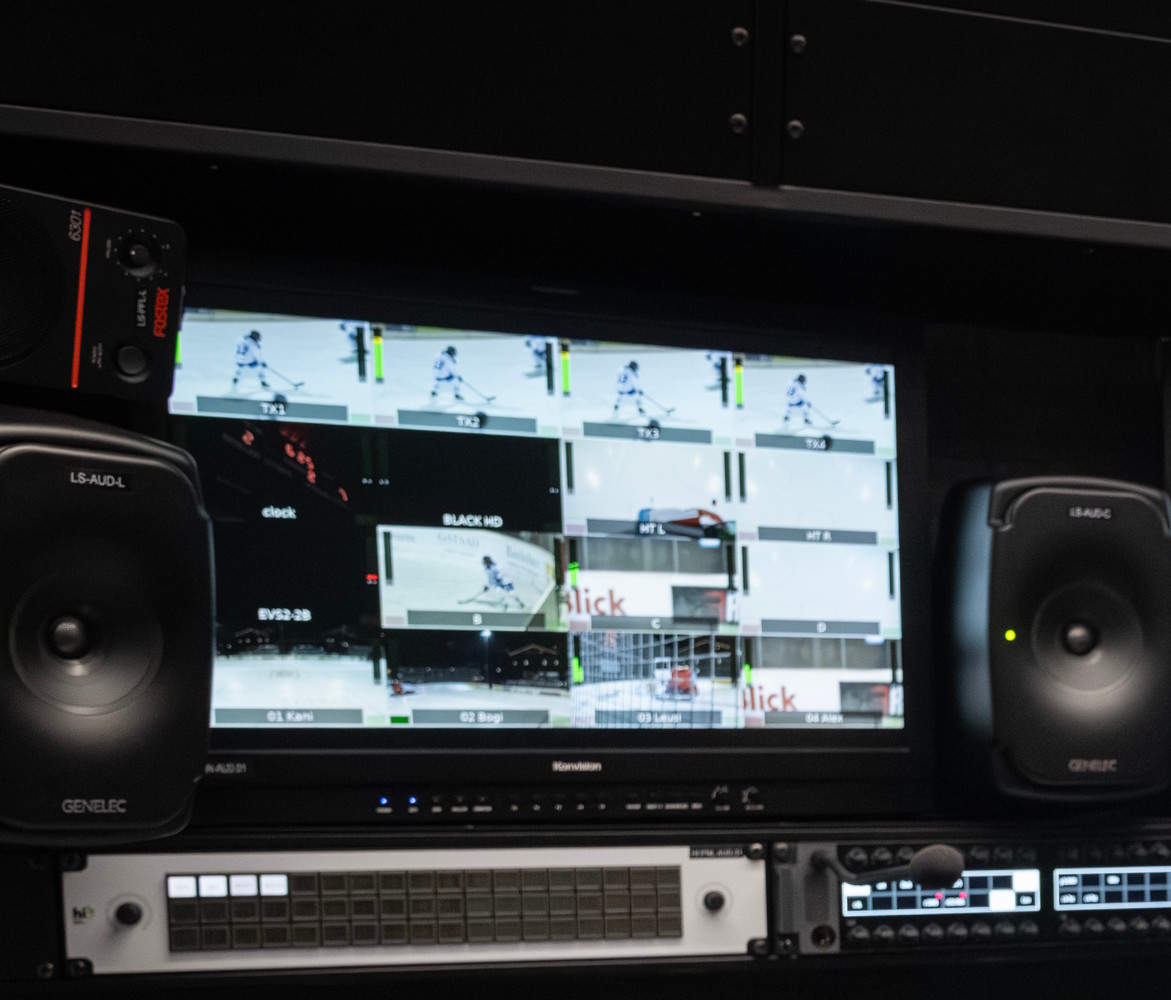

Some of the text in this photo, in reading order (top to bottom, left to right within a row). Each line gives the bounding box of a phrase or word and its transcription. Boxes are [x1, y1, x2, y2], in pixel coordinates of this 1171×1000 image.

[68, 208, 83, 242] 6301
[153, 286, 170, 339] FOSTEX
[260, 402, 286, 415] TX1
[456, 416, 480, 428] TX2
[636, 428, 660, 440] TX3
[70, 472, 126, 488] LS-AUD-L
[262, 506, 297, 520] clock
[443, 513, 503, 528] BLACK HD
[61, 799, 127, 814] GENELEC
